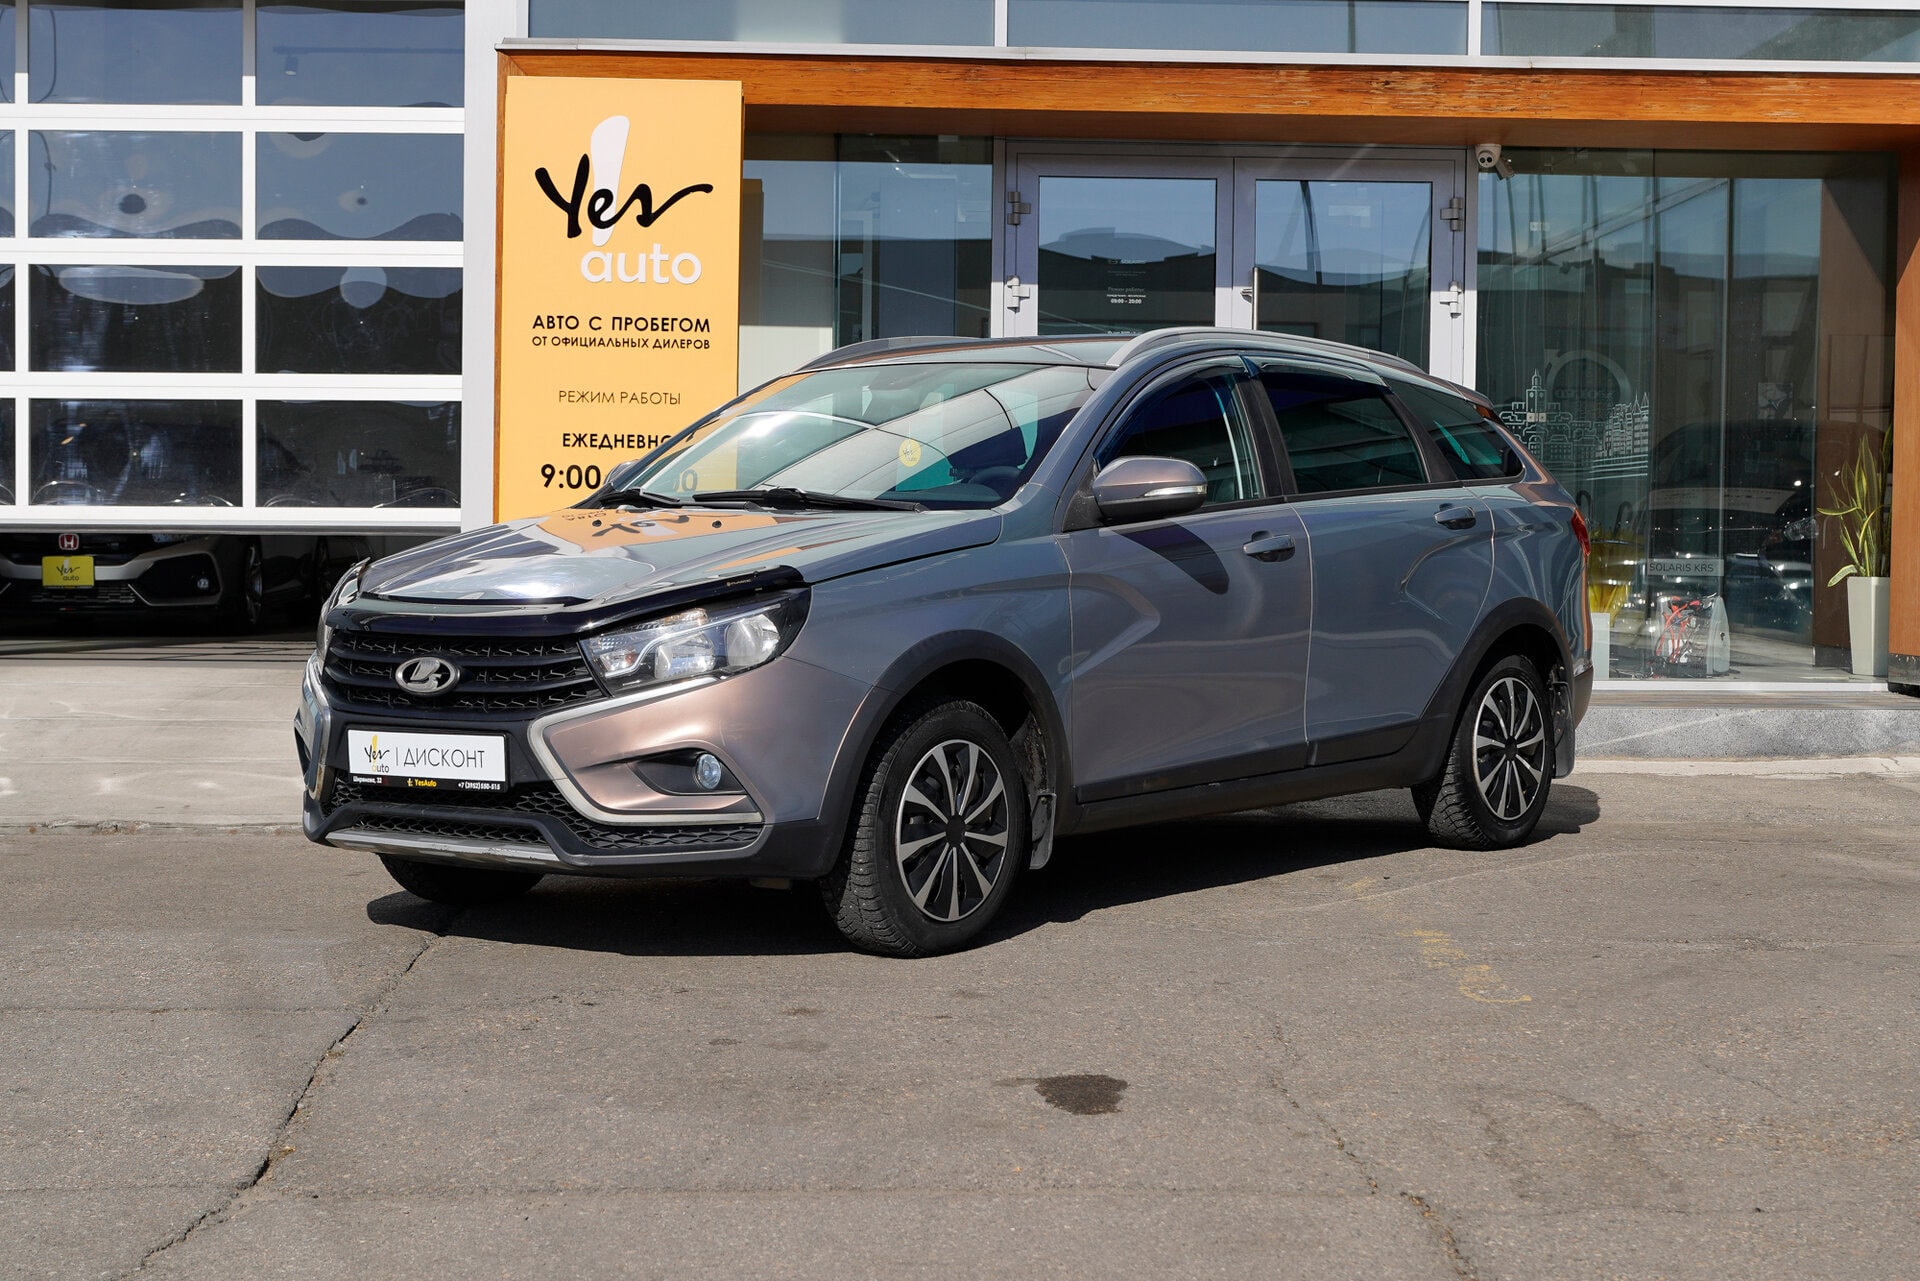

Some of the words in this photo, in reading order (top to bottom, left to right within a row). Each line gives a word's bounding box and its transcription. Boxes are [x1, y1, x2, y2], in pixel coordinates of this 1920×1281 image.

[534, 153, 714, 238] Yes
[580, 244, 703, 285] auto
[532, 315, 579, 331] АВТО
[588, 316, 602, 332] С
[611, 316, 711, 333] ПРОБЕГОМ
[532, 336, 547, 347] ОТ
[551, 336, 650, 349] ОФИЦИАЛЬНЫХ
[652, 338, 711, 350] ДИЛЕРОВ
[558, 390, 615, 404] РЕЖИМ
[620, 391, 681, 406] РАБОТЫ
[540, 463, 601, 490] 9:00
[1649, 563, 1691, 572] SOLARIS
[1694, 564, 1714, 572] KRS
[364, 745, 390, 763] Yes
[403, 748, 485, 768] ДИСКОНТ
[371, 764, 390, 773] auto
[414, 779, 437, 787] YesAuto
